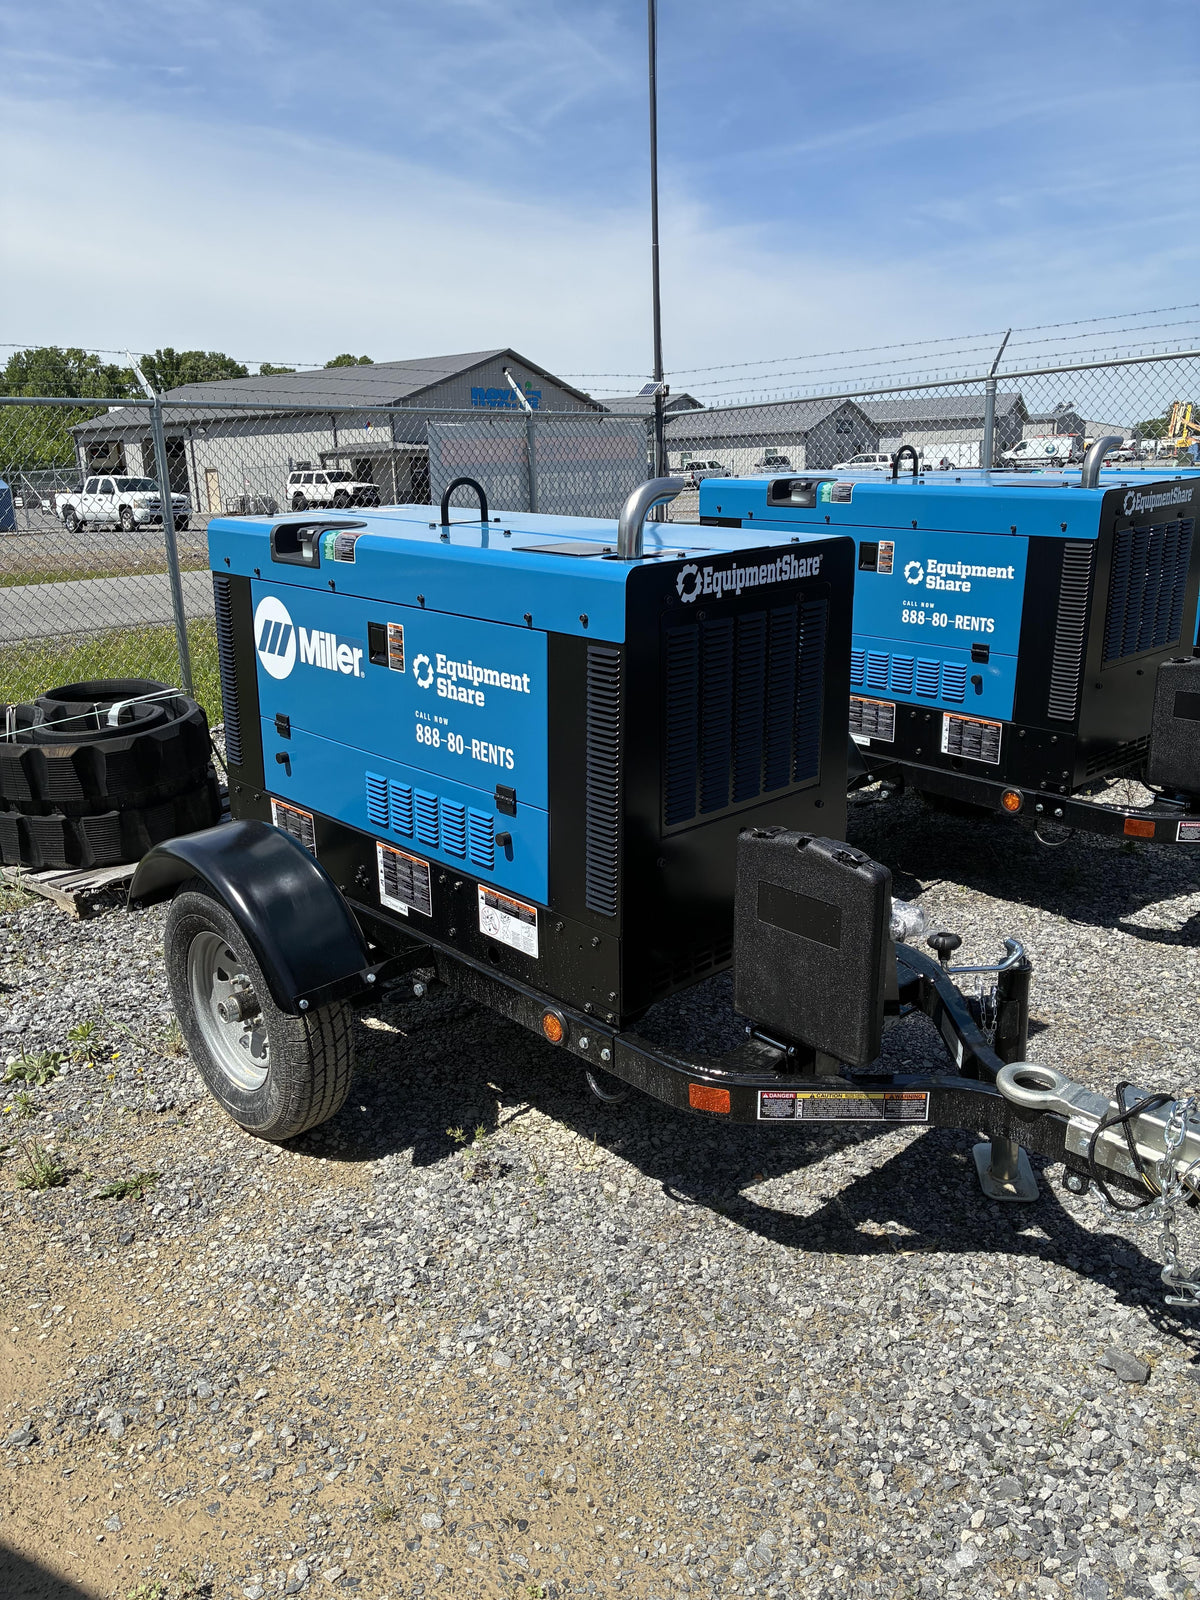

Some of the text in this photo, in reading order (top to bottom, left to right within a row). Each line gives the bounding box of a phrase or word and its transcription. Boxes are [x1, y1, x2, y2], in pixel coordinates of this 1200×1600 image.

[1135, 486, 1193, 514] EquipmentShare
[702, 554, 821, 599] EquipmentShare
[925, 575, 972, 593] Share
[926, 559, 1015, 580] Equipment
[901, 609, 995, 633] 888-80-RENTS
[298, 626, 363, 678] Miller
[435, 653, 531, 694] Equipment
[436, 677, 485, 707] Share
[415, 710, 449, 726] CALL NOW
[415, 723, 515, 770] 888-80-RENTS
